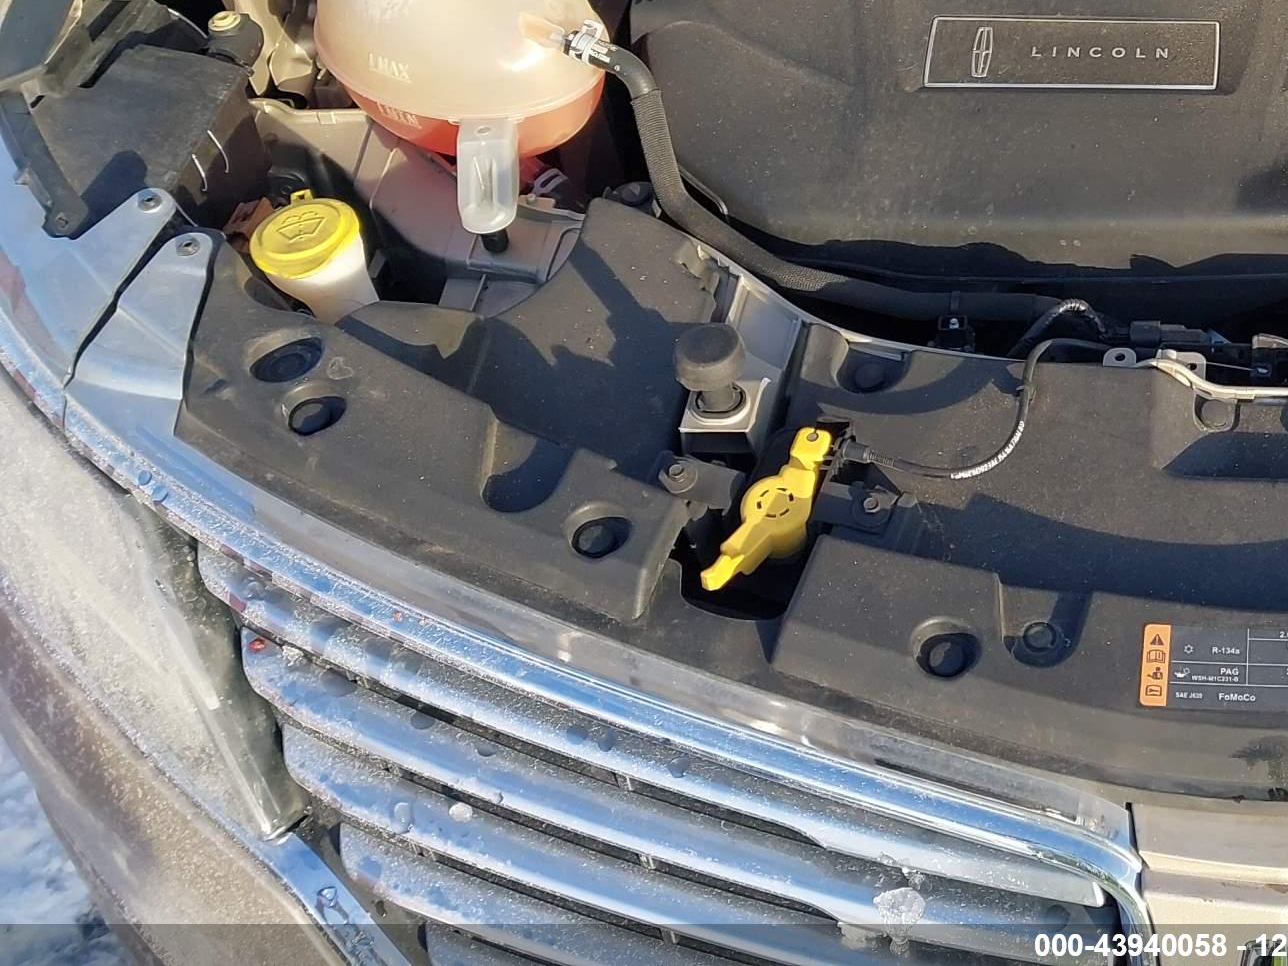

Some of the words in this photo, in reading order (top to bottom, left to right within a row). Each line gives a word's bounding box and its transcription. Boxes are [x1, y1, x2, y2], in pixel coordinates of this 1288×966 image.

[1031, 46, 1170, 59] LINCOLN
[1211, 646, 1240, 655] R-134a
[1220, 667, 1239, 676] PAG
[1175, 691, 1188, 699] SAE
[1218, 692, 1256, 702] FoMoCo
